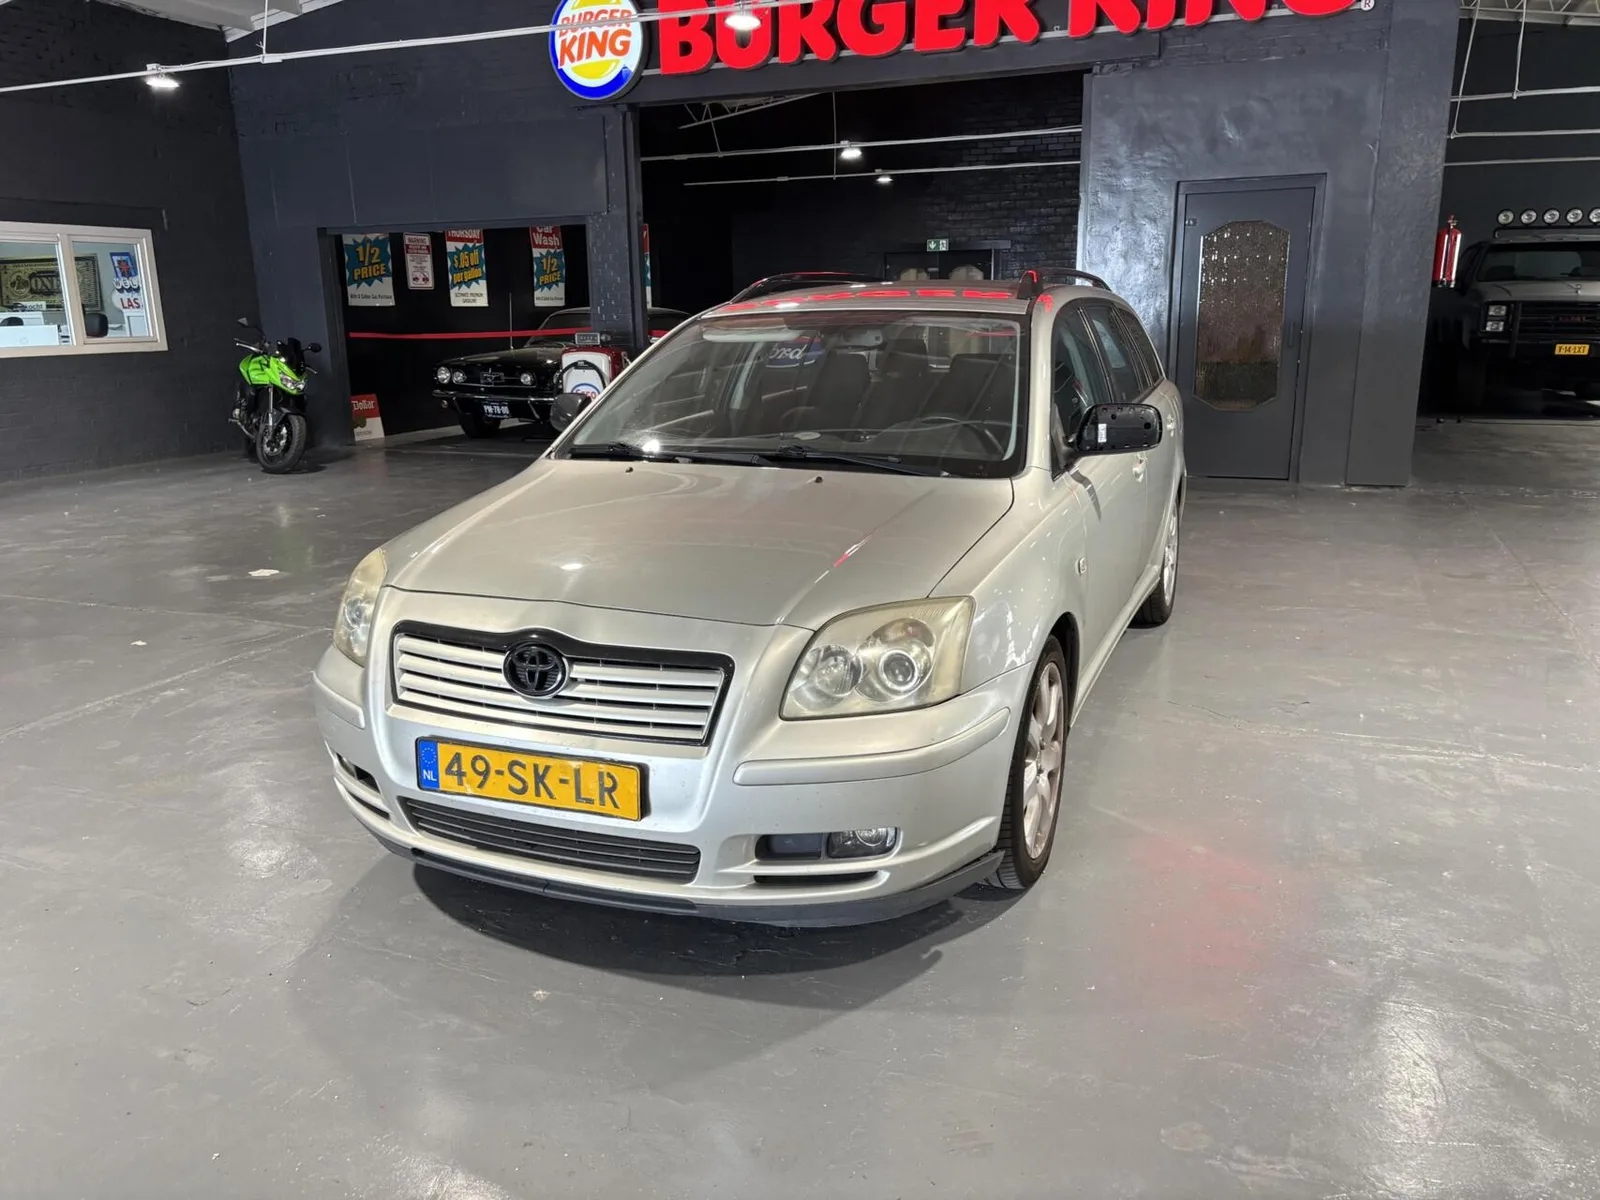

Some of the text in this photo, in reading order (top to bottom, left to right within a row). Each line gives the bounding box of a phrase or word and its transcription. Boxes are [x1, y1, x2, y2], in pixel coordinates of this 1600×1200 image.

[559, 9, 632, 37] BURGER
[659, 0, 1040, 74] BURGER
[559, 29, 632, 66] KING
[533, 232, 560, 246] Wash
[356, 243, 381, 265] 1/2
[353, 263, 386, 281] PRICE
[541, 255, 558, 274] 1/2
[539, 271, 561, 286] PRICE
[120, 297, 141, 309] LAS
[423, 769, 437, 782] NL
[444, 752, 620, 810] 49-SK-LR
